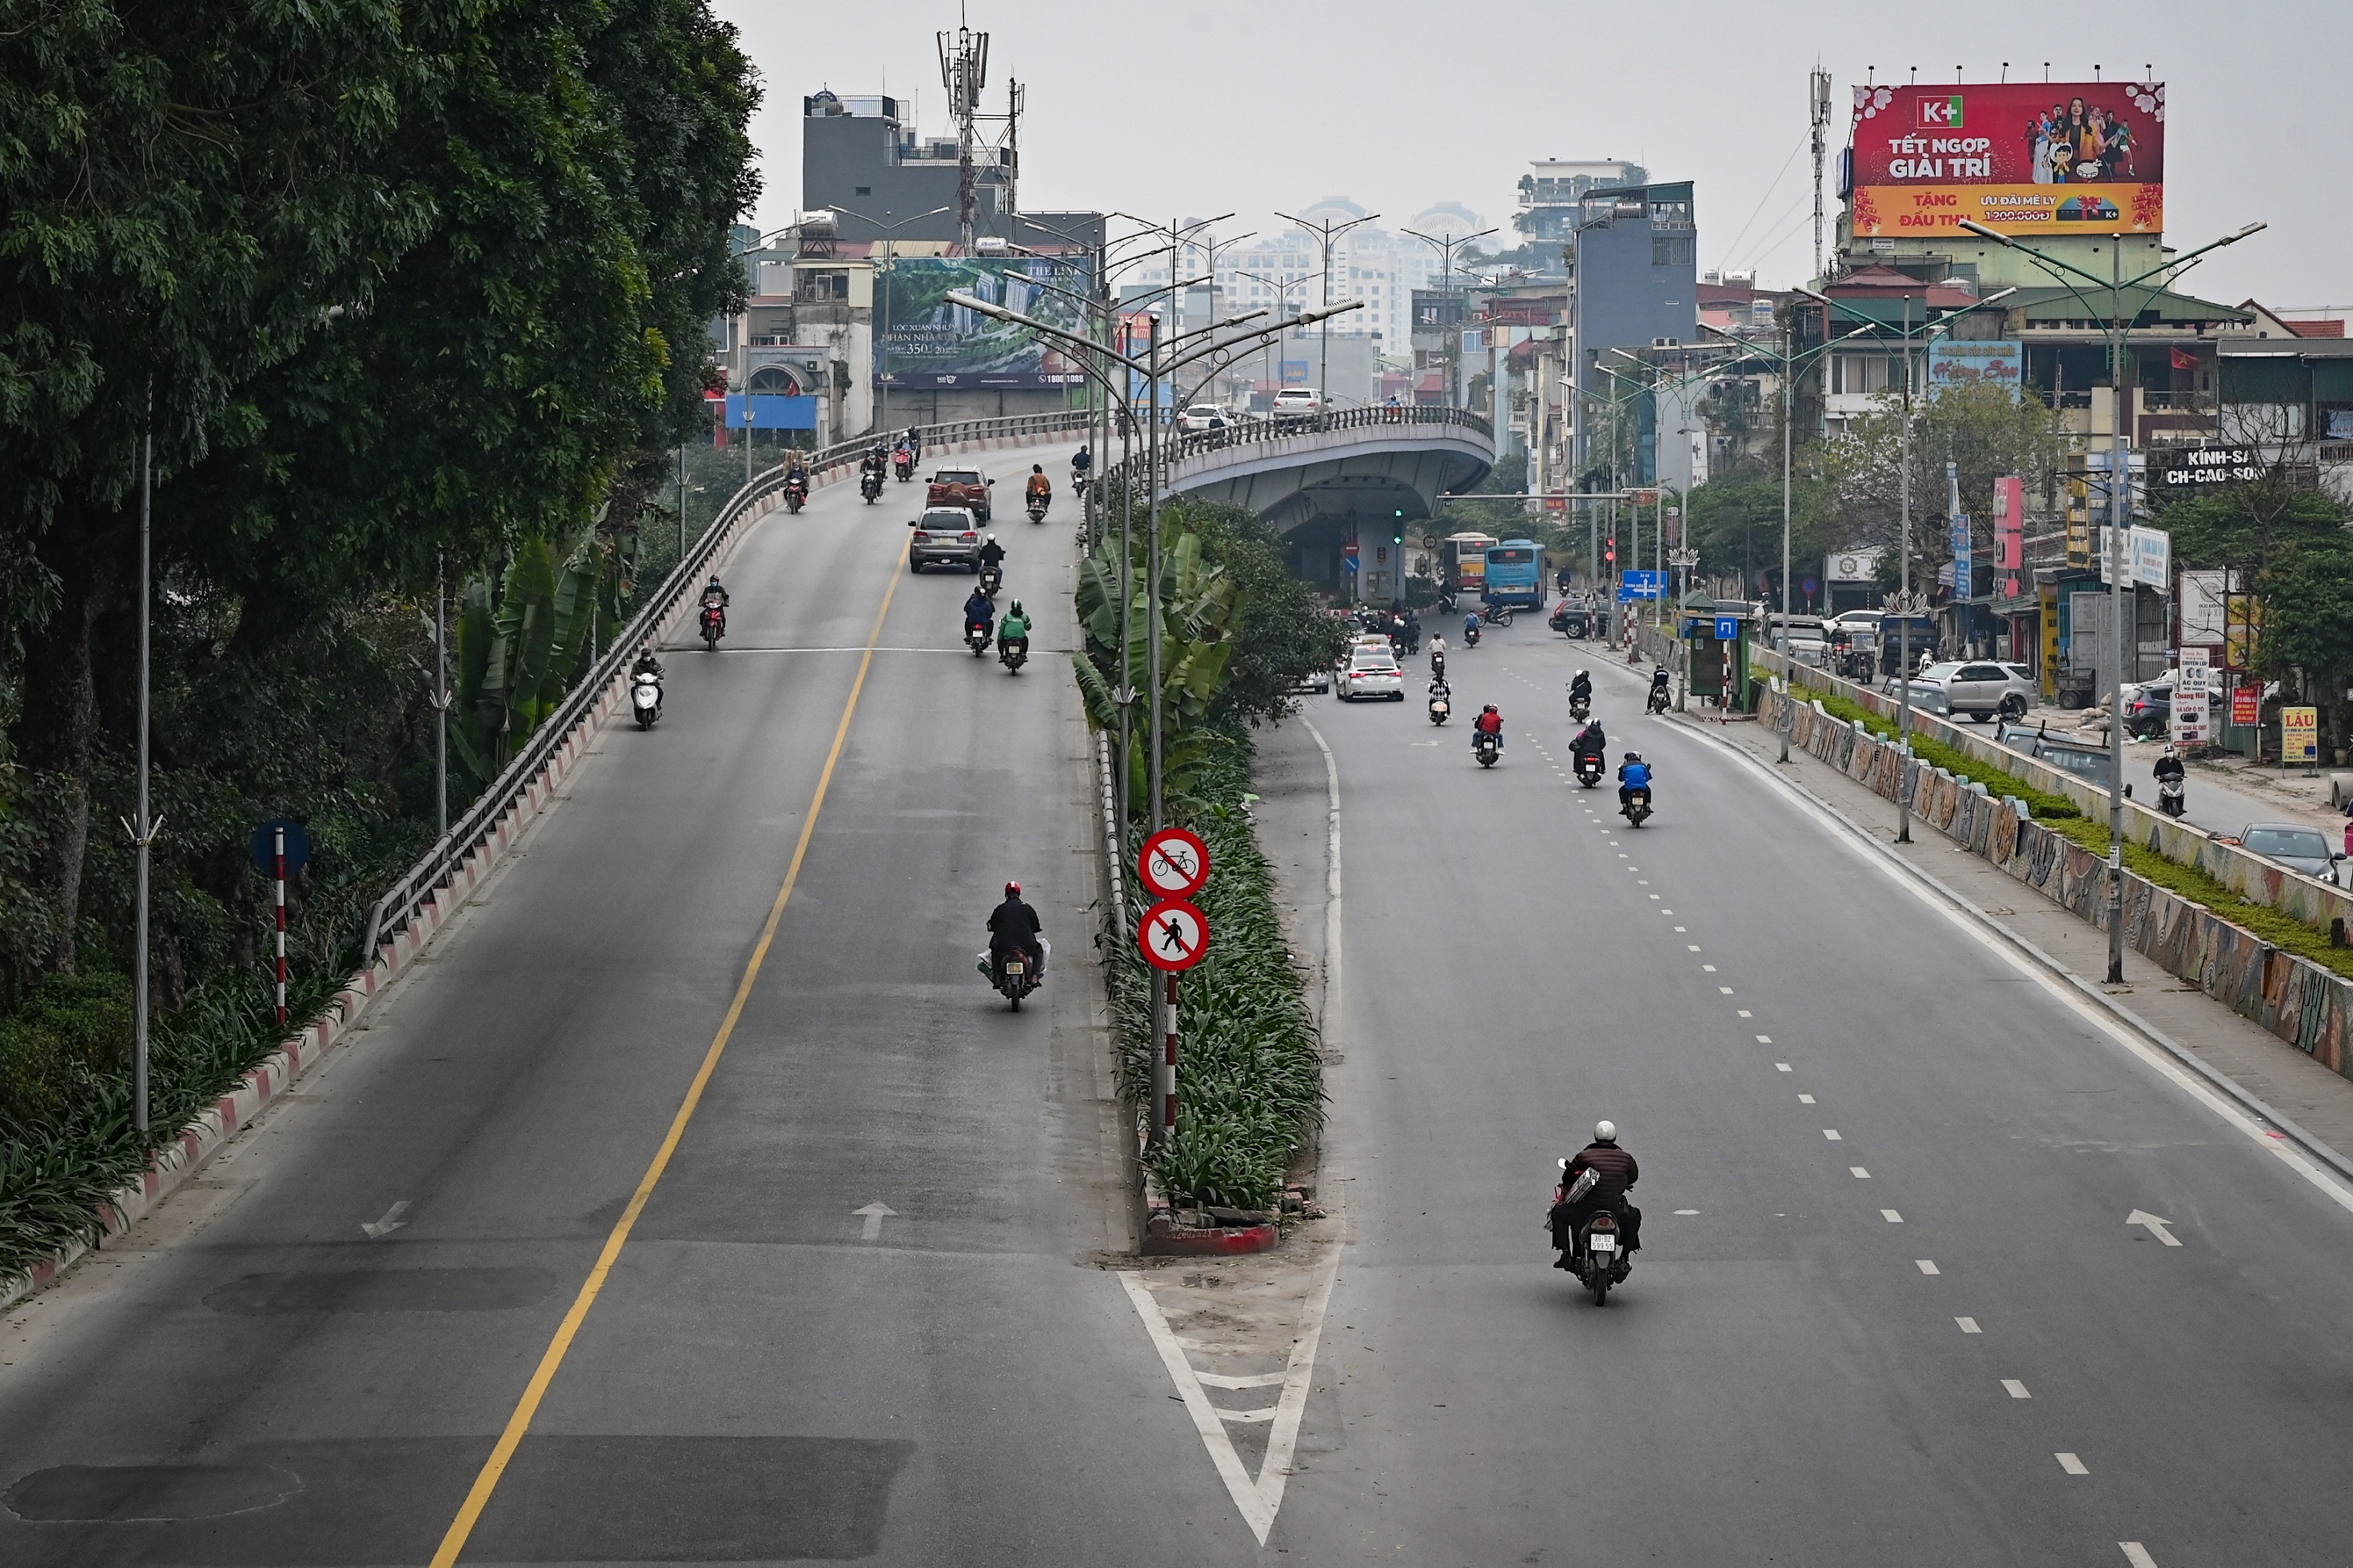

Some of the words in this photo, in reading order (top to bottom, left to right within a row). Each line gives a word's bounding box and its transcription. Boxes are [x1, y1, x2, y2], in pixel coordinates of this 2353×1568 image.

[1924, 102, 1957, 122] K+
[1888, 132, 1928, 154] TẾT
[1932, 138, 1990, 157] NGỢP
[1889, 154, 1942, 178] GIẢI
[1948, 153, 1991, 177] TRÍ
[1913, 192, 1957, 209] TẶNG
[1980, 195, 1997, 205] ƯU
[2000, 194, 2021, 205] ĐÃI
[2023, 194, 2040, 205] MÊ
[2043, 196, 2057, 205] LY
[1900, 210, 1935, 226] ĐẦU
[1028, 266, 1051, 276] THE
[1055, 266, 1082, 276] LINK
[907, 343, 928, 354] 350
[935, 346, 944, 354] 20
[1047, 375, 1064, 383] 1800
[1067, 375, 1084, 383] 1088
[2285, 710, 2315, 727] LẨU
